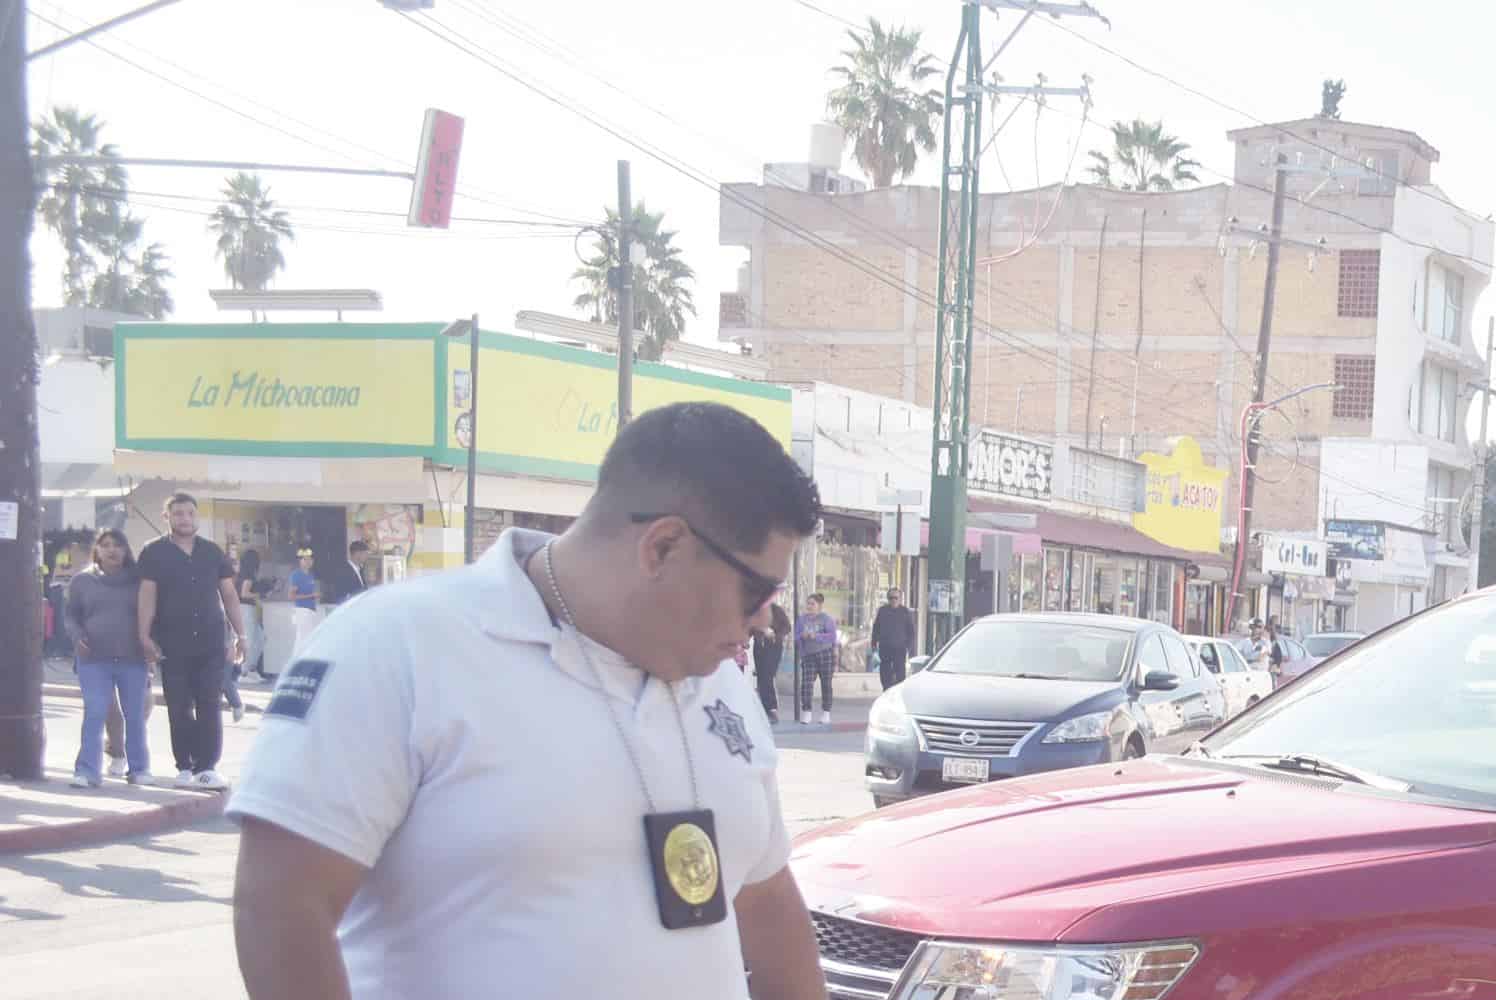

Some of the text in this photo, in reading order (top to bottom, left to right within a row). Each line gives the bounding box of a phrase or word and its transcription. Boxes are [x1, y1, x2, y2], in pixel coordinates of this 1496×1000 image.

[187, 370, 361, 408] La Michoacana
[577, 402, 602, 433] La
